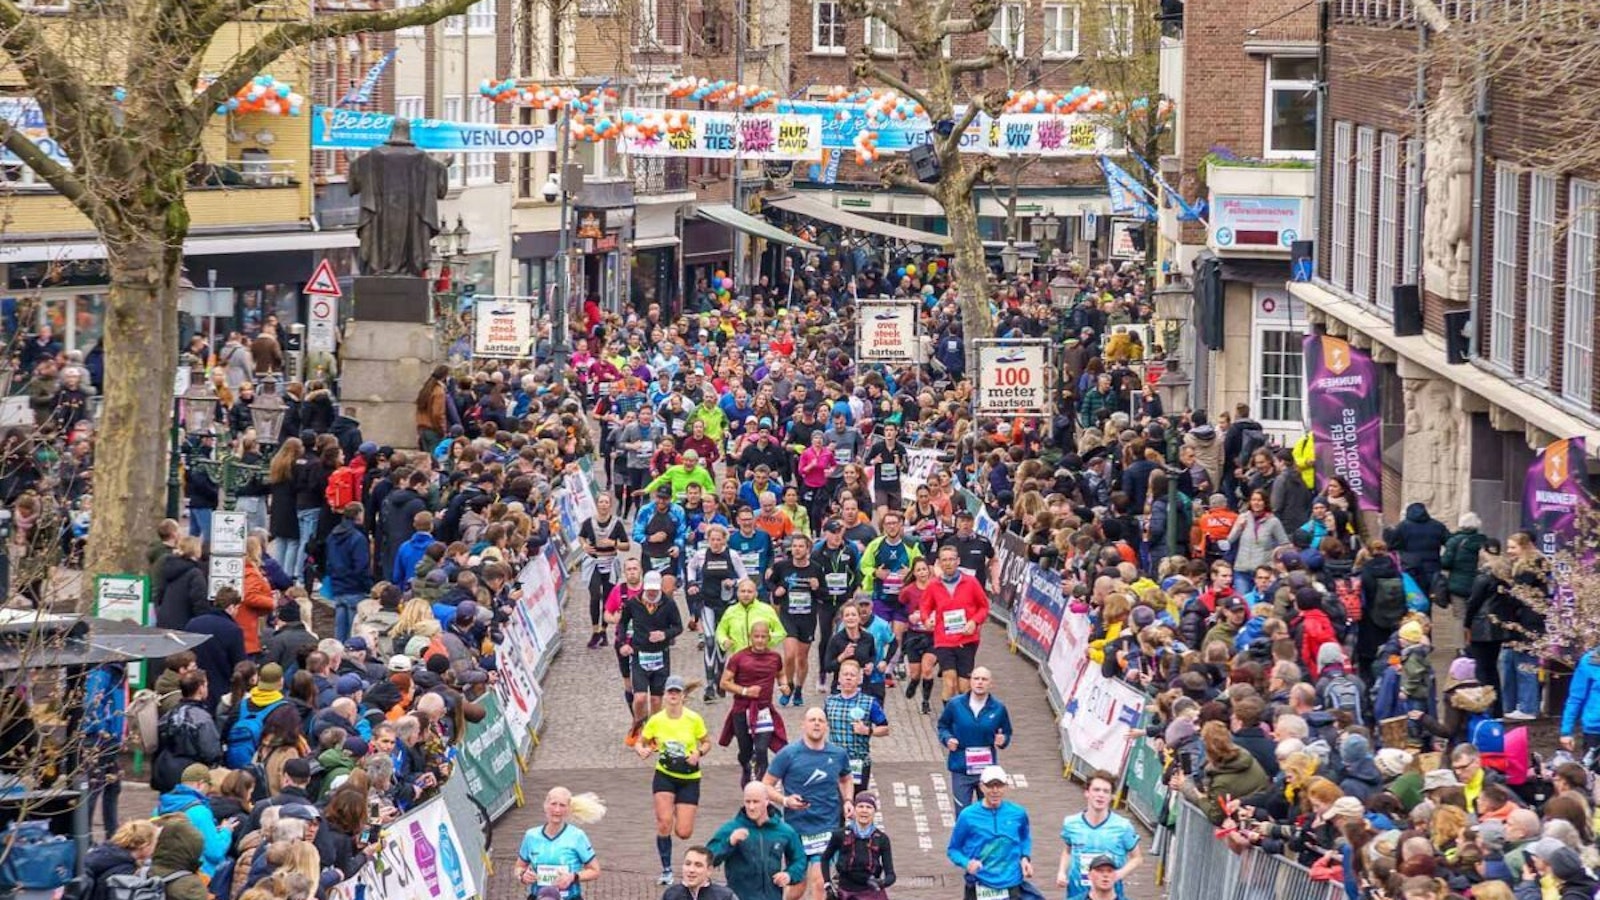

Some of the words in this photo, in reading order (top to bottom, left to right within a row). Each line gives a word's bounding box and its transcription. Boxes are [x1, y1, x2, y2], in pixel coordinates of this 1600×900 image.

[706, 123, 735, 135] HUP!
[741, 119, 772, 131] HUP!
[1007, 122, 1033, 133] HUP!
[1070, 125, 1096, 134] HUP!
[779, 126, 810, 137] HUP!
[460, 129, 544, 146] VENLOOP
[1007, 134, 1031, 146] VIV
[1068, 135, 1096, 145] ANITA
[669, 140, 697, 150] MIJN
[703, 137, 736, 150] TIES
[778, 139, 808, 149] DAVID
[875, 330, 900, 338] steek
[873, 338, 901, 347] plaats
[484, 344, 520, 352] aartsen
[868, 348, 905, 356] aartsen
[995, 368, 1030, 386] 100
[988, 387, 1036, 397] meter
[989, 399, 1034, 407] aartsen
[1536, 490, 1577, 504] NUNNER
